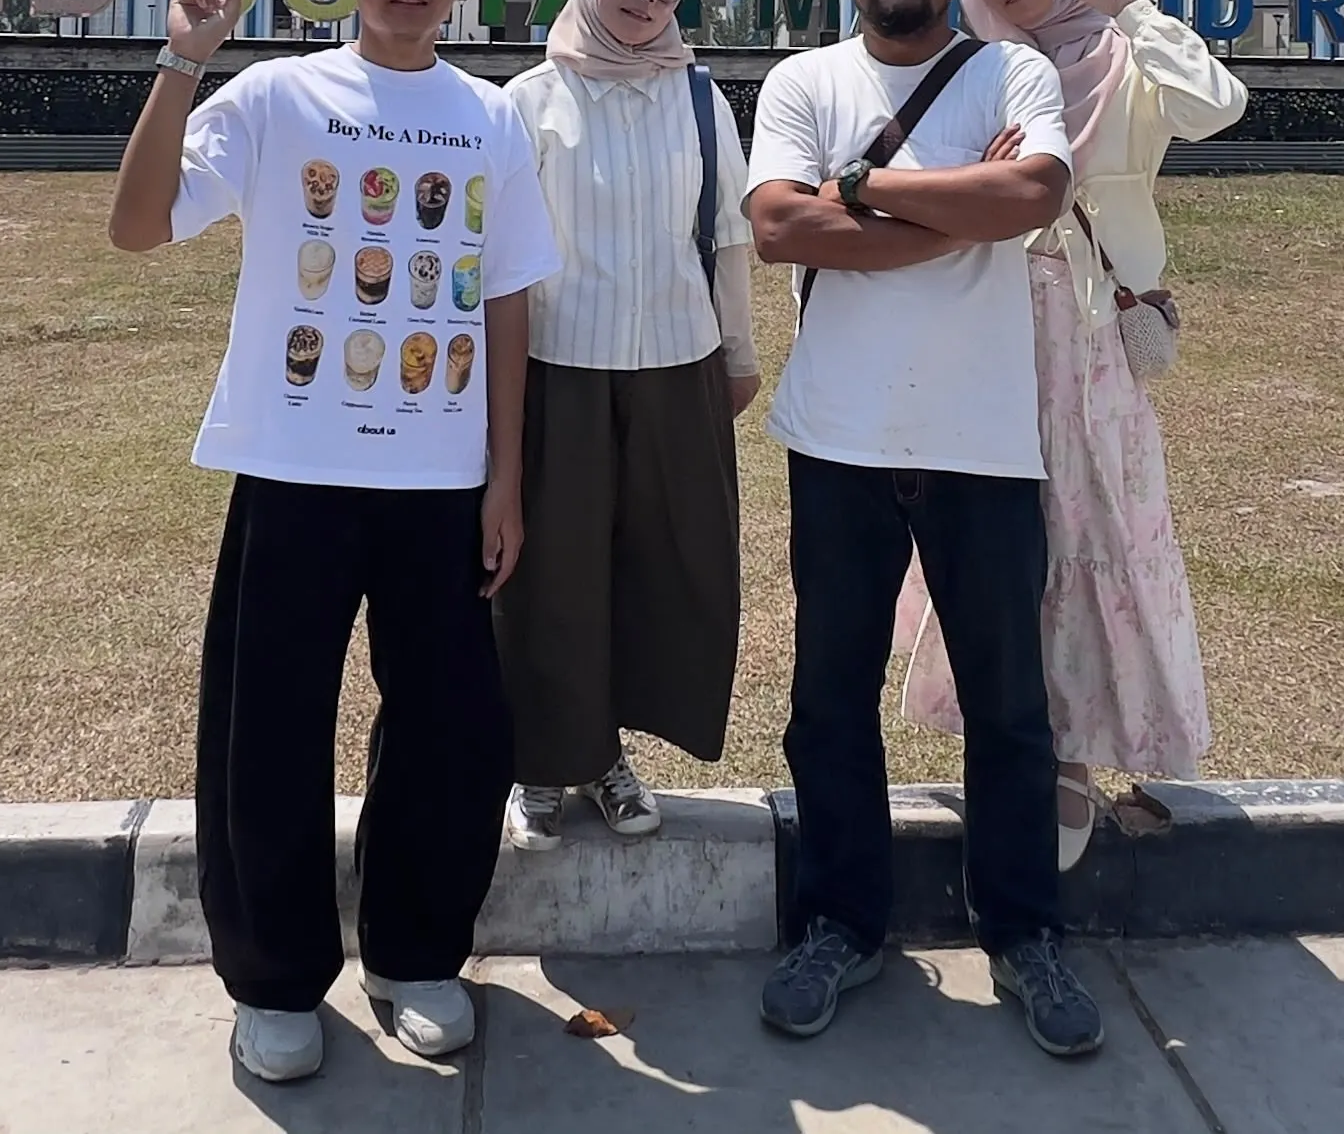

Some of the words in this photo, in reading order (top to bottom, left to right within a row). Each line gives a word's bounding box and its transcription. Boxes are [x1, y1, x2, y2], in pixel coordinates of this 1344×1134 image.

[327, 118, 363, 141] Buy
[367, 124, 395, 141] Me
[398, 129, 412, 144] A
[417, 129, 472, 148] Drink
[357, 424, 385, 435] about
